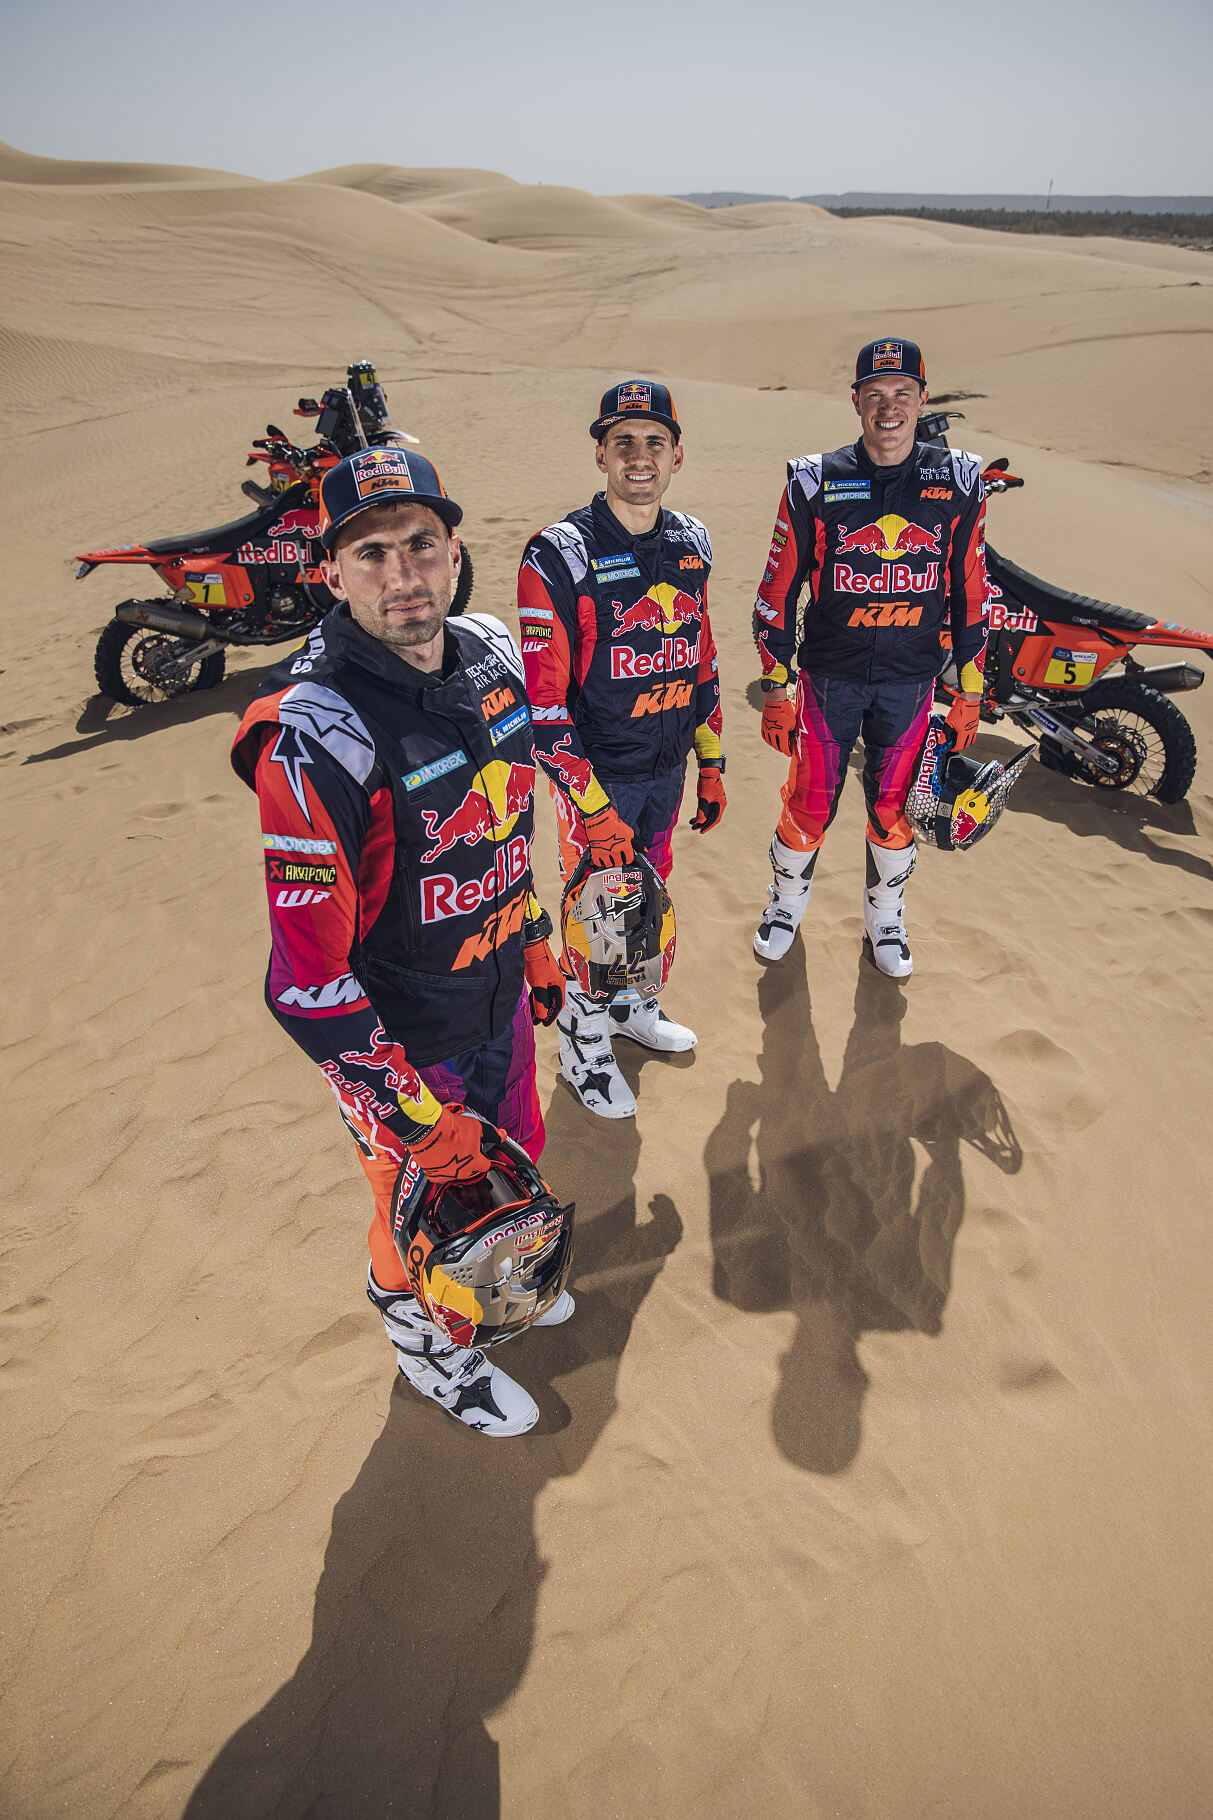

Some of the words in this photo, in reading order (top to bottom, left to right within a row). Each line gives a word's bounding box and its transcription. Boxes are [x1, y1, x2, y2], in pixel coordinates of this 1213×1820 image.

[619, 393, 634, 404] Red
[634, 392, 650, 402] Bull
[356, 464, 382, 482] Red
[381, 462, 408, 476] Bull
[920, 467, 935, 475] TECH
[920, 473, 933, 481] AIR
[935, 473, 951, 481] BAG
[370, 478, 400, 490] KTM
[919, 486, 954, 501] KTM
[835, 492, 870, 501] MOTOREX
[237, 540, 281, 565] Red
[604, 556, 631, 566] MICHELIN
[678, 554, 704, 571] KTM
[834, 562, 891, 594] Red
[891, 561, 940, 594] Bull
[202, 584, 210, 604] 1
[846, 601, 924, 628] KTM
[988, 603, 1039, 633] Bull
[610, 637, 673, 680] Red
[464, 662, 484, 680] TECH
[473, 673, 492, 691] AIR
[1063, 662, 1076, 685] 5
[480, 686, 516, 722] KTM
[630, 679, 694, 718] KTM
[502, 711, 527, 733] MICHELIN
[923, 727, 942, 763] Red
[419, 751, 465, 783] MOTOREX
[915, 761, 937, 796] Bull
[274, 836, 336, 854] MOTOREX
[420, 844, 507, 925] Red
[602, 872, 623, 885] Bull
[622, 871, 643, 884] Red
[450, 888, 529, 972] KTM
[607, 950, 647, 977] 77
[606, 972, 647, 986] FASTER
[276, 972, 368, 1009] KTM
[317, 1059, 367, 1096] Red
[353, 1086, 399, 1120] Bull
[541, 1214, 564, 1236] Red
[513, 1228, 543, 1246] Bull
